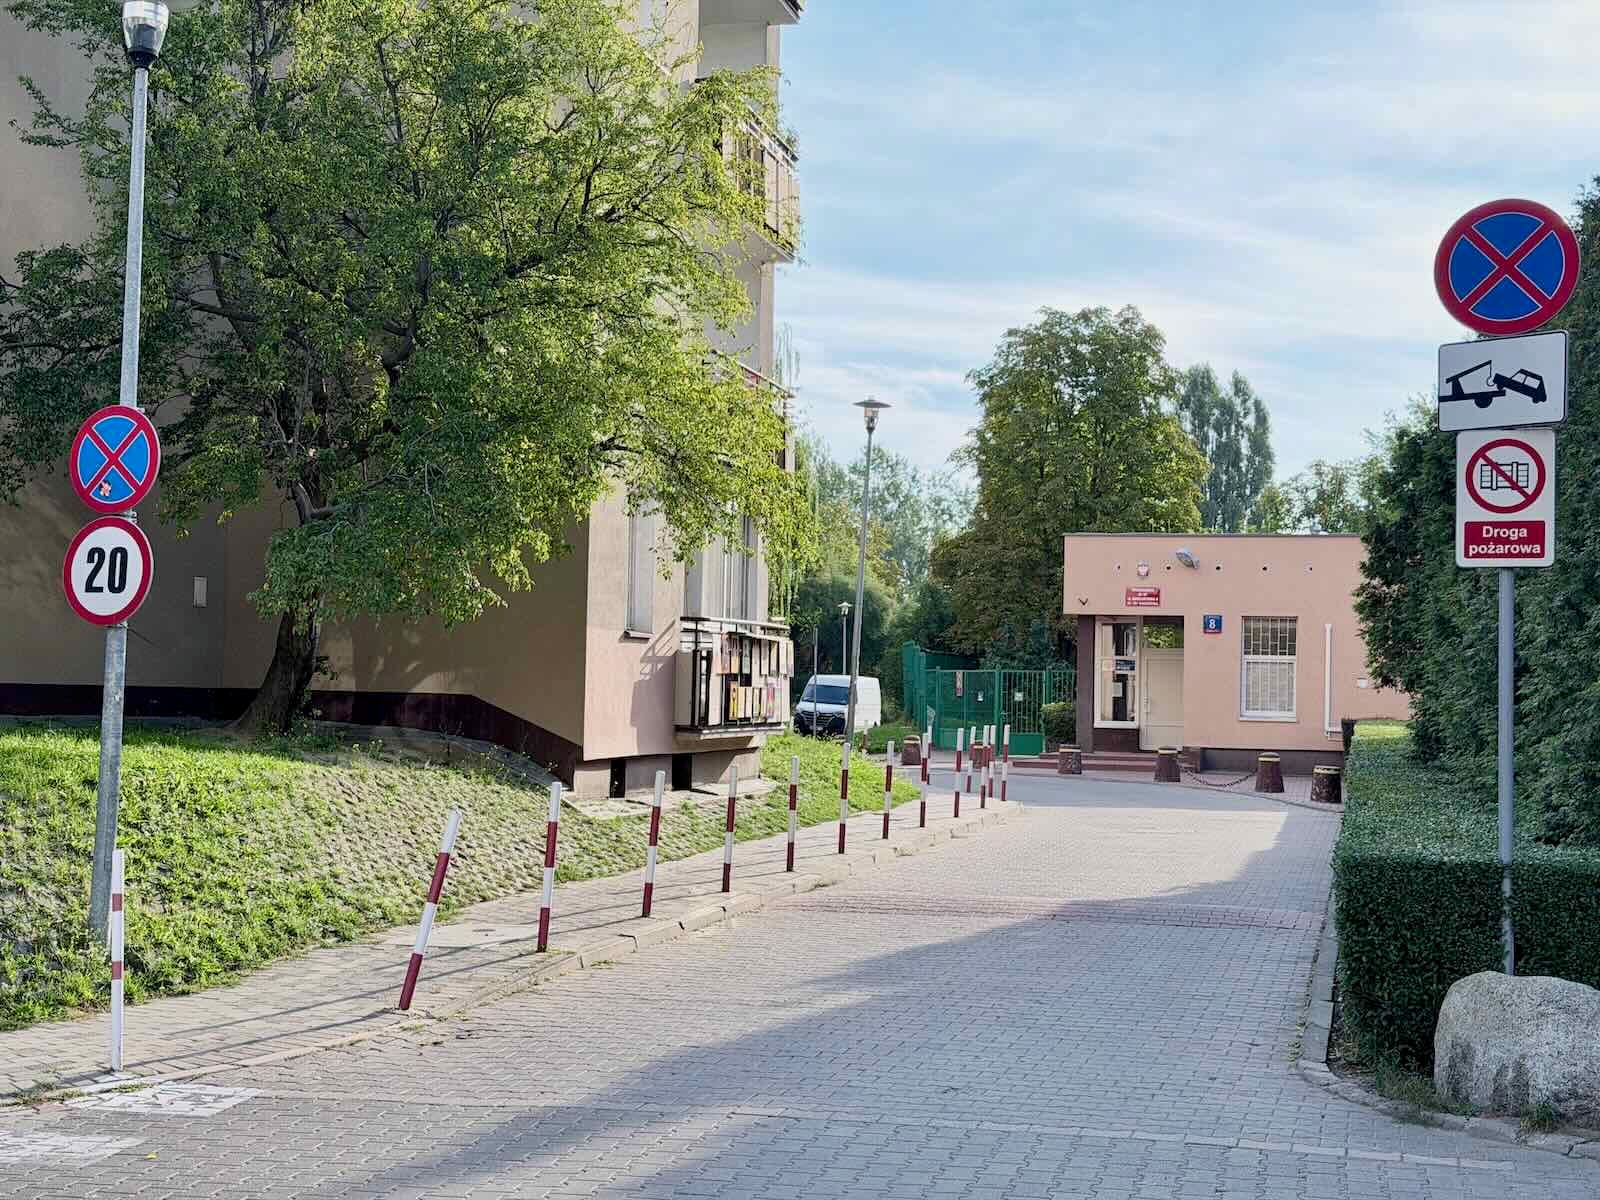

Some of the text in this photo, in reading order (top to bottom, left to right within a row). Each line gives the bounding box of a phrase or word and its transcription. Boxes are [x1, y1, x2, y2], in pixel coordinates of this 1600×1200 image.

[1483, 526, 1528, 540] Droga
[1468, 541, 1541, 557] pożarowa
[84, 546, 129, 594] 20
[1208, 618, 1216, 629] 8
